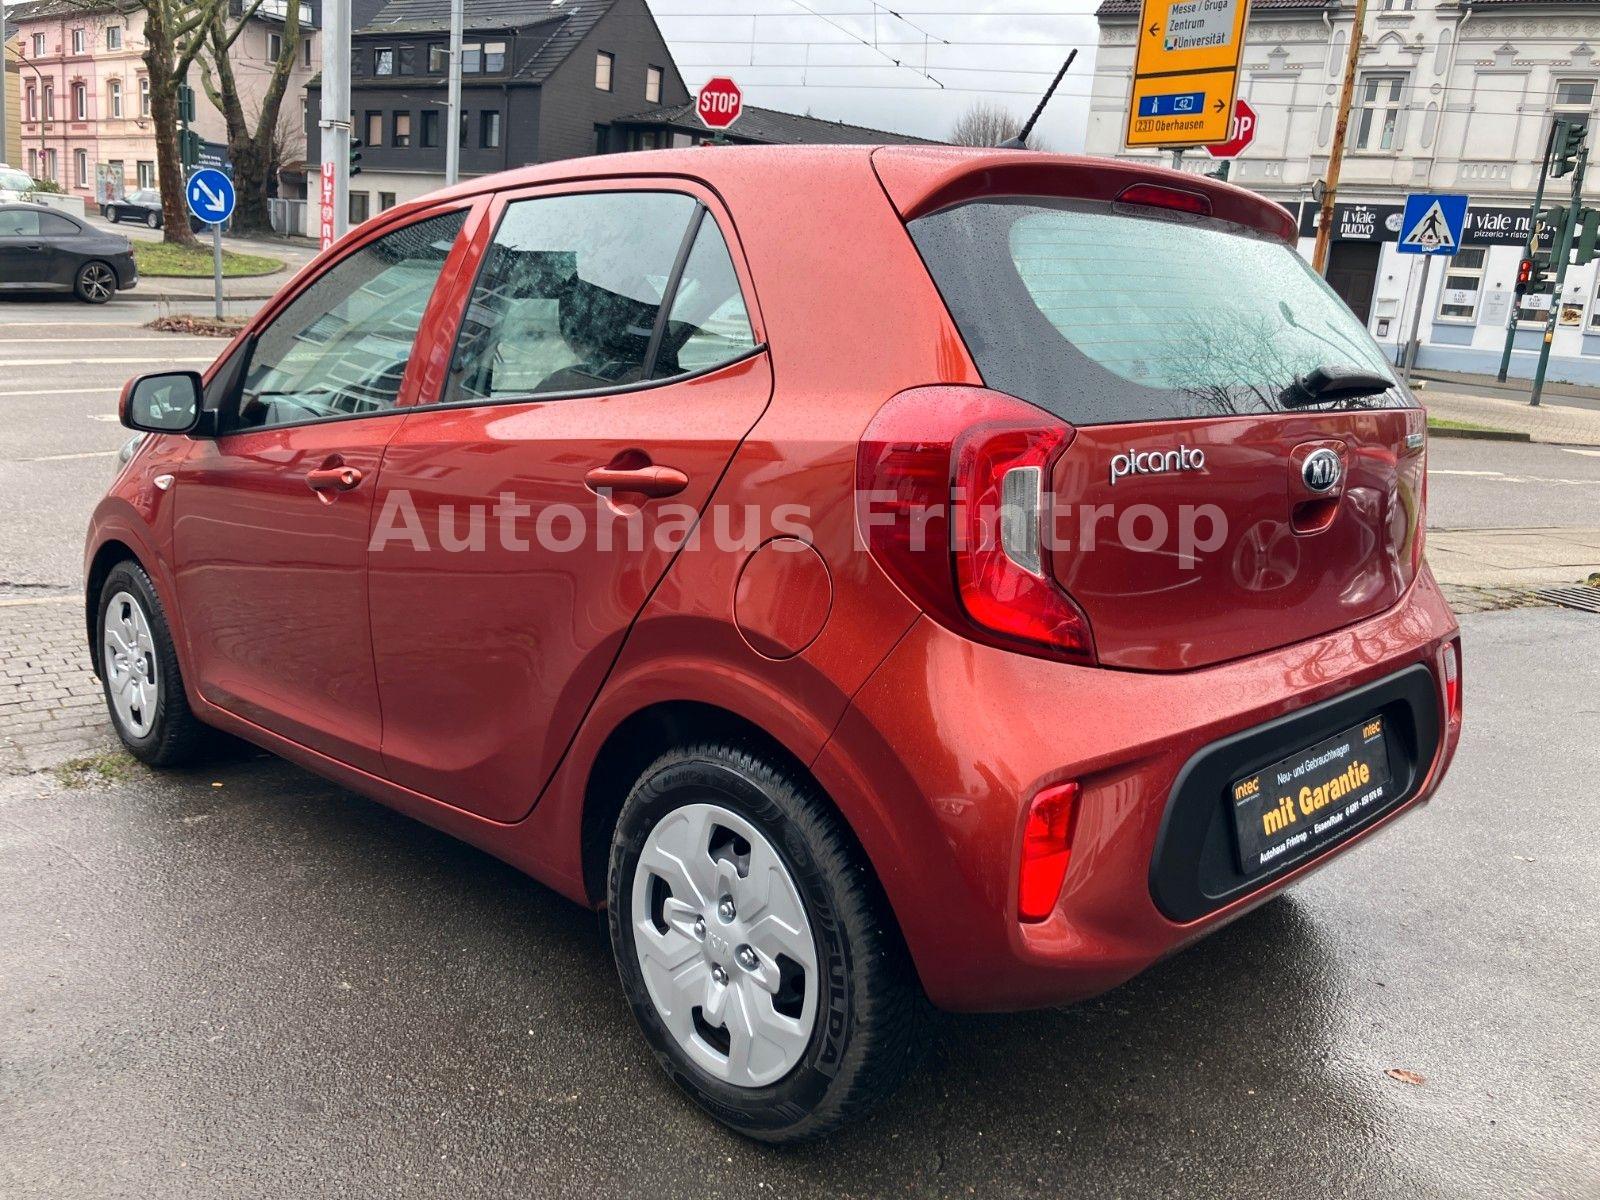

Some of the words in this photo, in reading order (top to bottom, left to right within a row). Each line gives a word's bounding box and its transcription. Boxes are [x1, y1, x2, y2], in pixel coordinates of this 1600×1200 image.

[1172, 4, 1196, 16] Messe
[1204, 0, 1228, 12] Gruga
[1169, 18, 1205, 32] Zentrum
[1178, 32, 1226, 48] Universität
[700, 91, 738, 113] STOP
[1179, 98, 1189, 109] 42
[1137, 120, 1151, 132] 231
[1155, 119, 1204, 132] Oberhausen
[1231, 116, 1252, 140] OP
[1342, 210, 1350, 223] il
[1351, 211, 1376, 224] viale
[1463, 212, 1473, 229] il
[1476, 213, 1512, 230] viale
[1340, 223, 1375, 235] nuovo
[1473, 230, 1504, 239] pizzeria
[1510, 231, 1549, 240] ristonte
[1110, 444, 1205, 486] picanto
[1311, 458, 1338, 484] KIA
[1362, 720, 1381, 739] intec
[1277, 771, 1293, 786] Neu-
[1292, 762, 1305, 778] und
[1304, 743, 1351, 772] Gebrauchtwagen
[1235, 776, 1259, 800] intec
[1262, 796, 1297, 836] mit
[1298, 760, 1370, 816] Garantie
[820, 929, 846, 1065] FULDA
